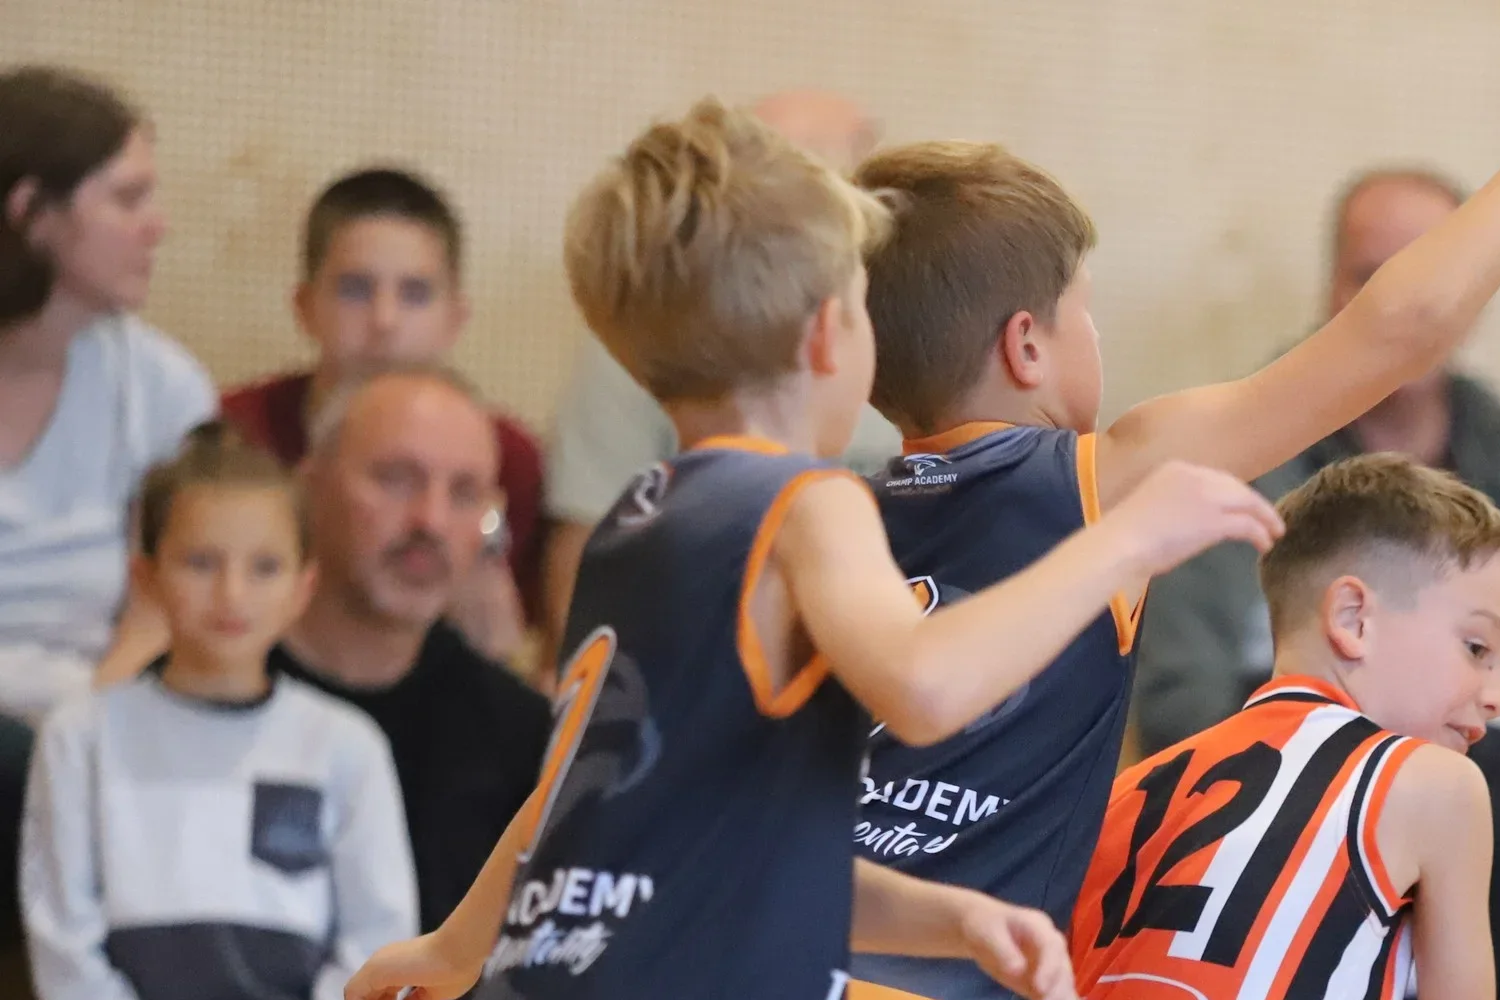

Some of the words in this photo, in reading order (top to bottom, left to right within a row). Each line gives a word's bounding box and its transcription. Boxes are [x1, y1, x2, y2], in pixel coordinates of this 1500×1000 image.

[886, 478, 913, 487] CHAMP
[914, 474, 958, 485] ACADEMY
[1093, 740, 1283, 949] 12
